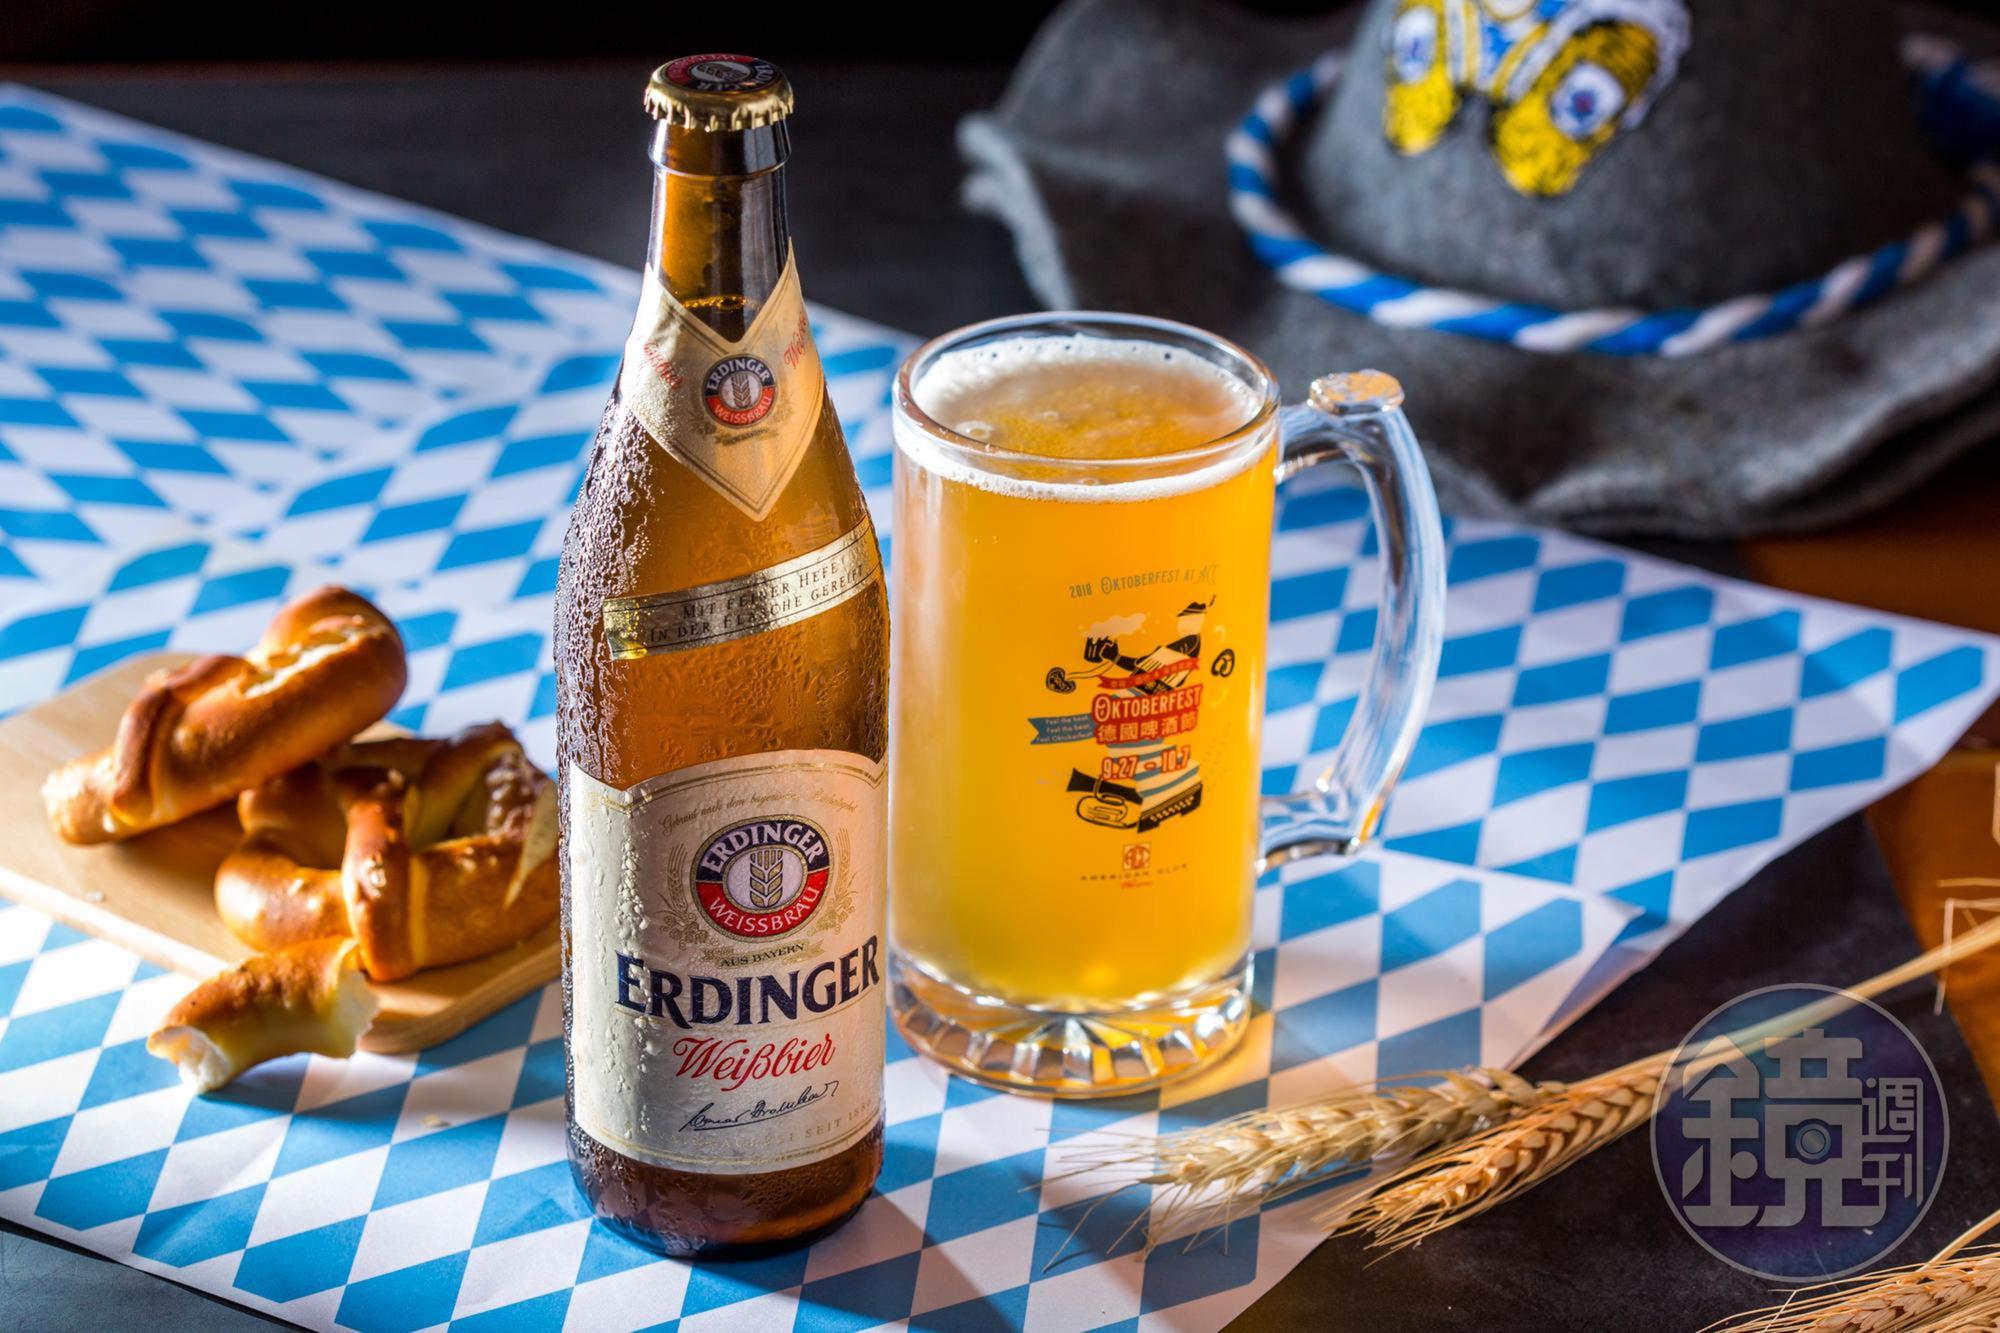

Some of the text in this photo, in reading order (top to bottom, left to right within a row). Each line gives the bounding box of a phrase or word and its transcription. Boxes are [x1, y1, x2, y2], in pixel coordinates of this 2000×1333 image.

[706, 358, 770, 390] ERDINGER
[649, 564, 864, 642] IN DER FLASCHE GEREIFT
[683, 603, 716, 620] MIT
[800, 562, 839, 588] HEFE
[1069, 583, 1092, 598] 2018
[1098, 711, 1197, 742] 德國啤酒節
[1102, 756, 1138, 779] 9.27
[1162, 746, 1190, 773] 10.7
[701, 822, 824, 873] ERDINGER
[709, 886, 820, 933] WEISSBRÄU
[720, 943, 805, 967] AUS BAYERN
[614, 935, 881, 1030] ERDINGER
[672, 1033, 837, 1092] Weißbier
[805, 1118, 843, 1137] SEIT
